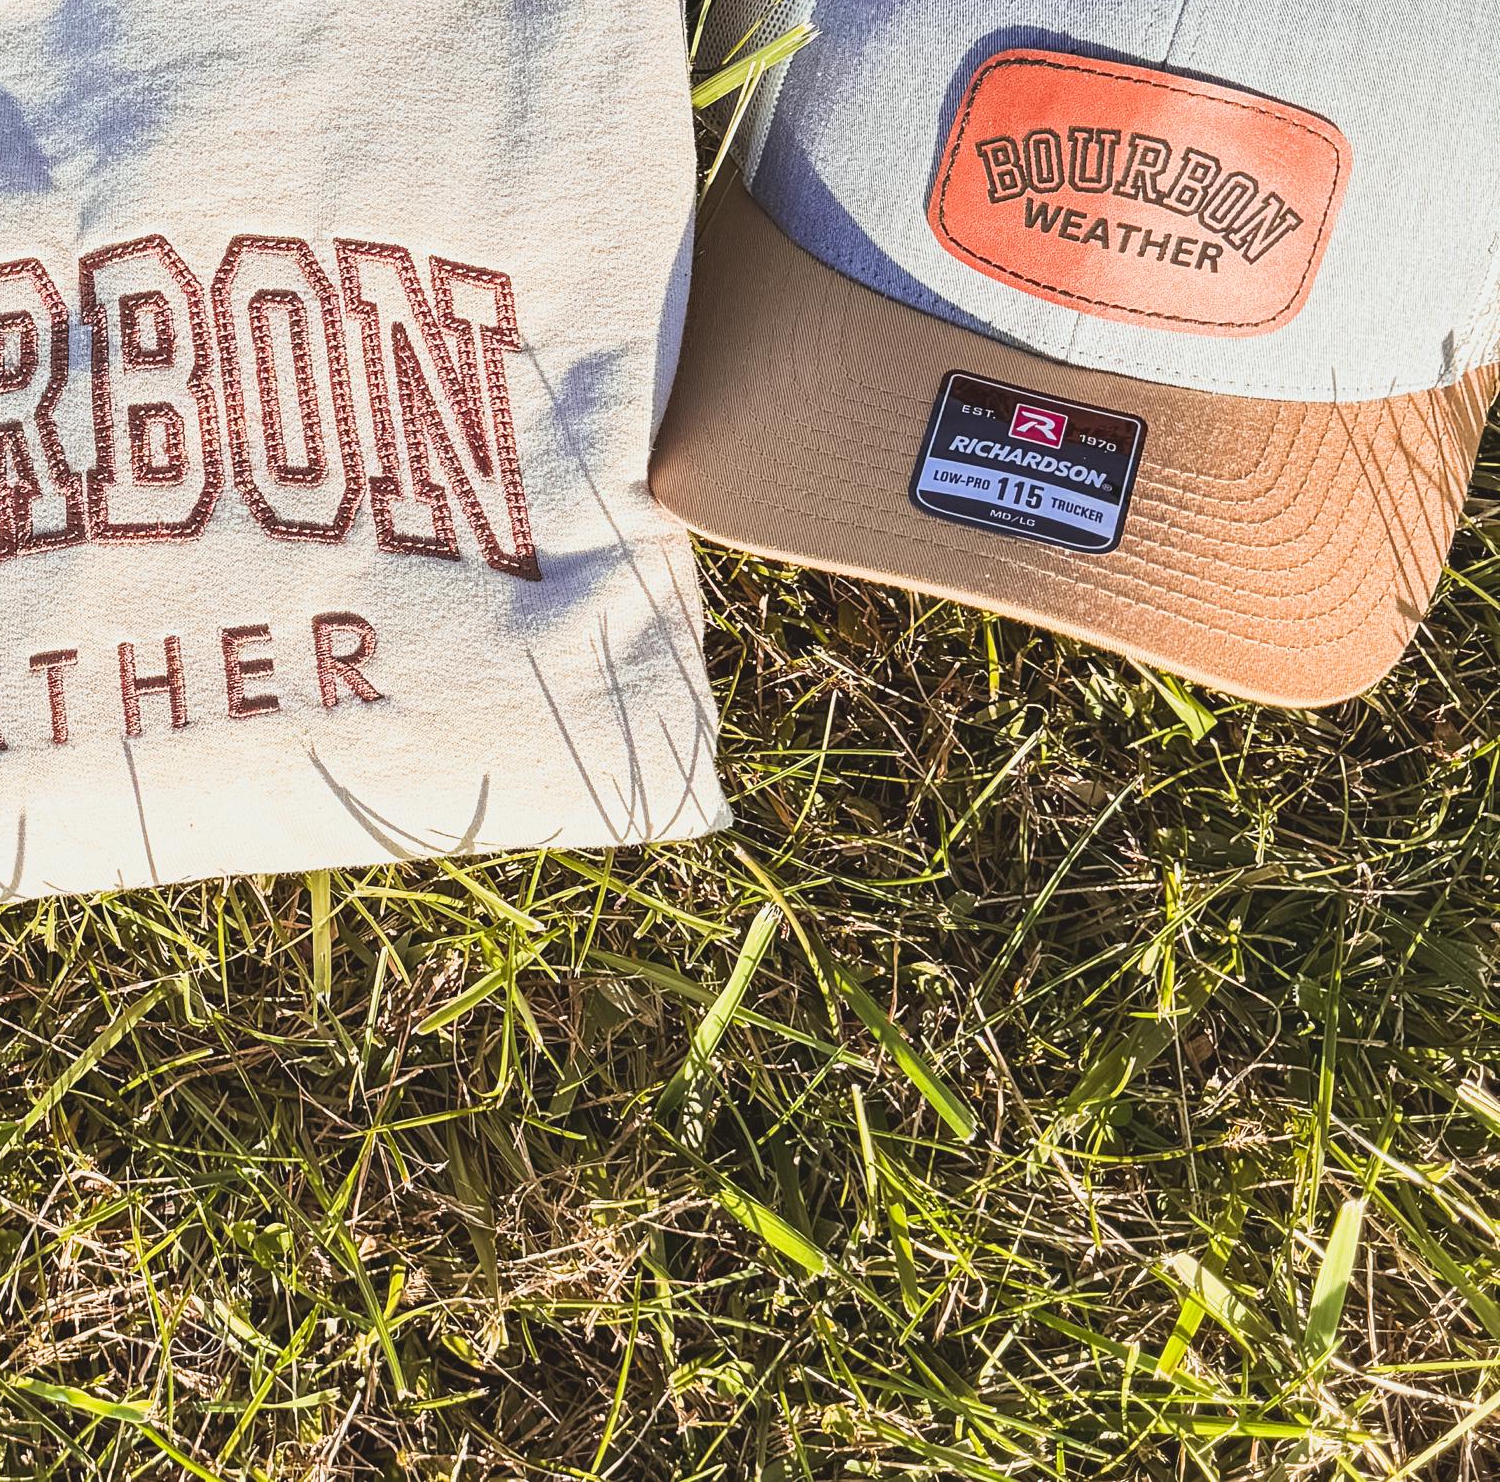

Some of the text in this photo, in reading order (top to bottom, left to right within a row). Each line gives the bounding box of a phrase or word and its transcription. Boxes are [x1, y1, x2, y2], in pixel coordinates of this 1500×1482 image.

[975, 126, 1301, 265] BOURBON
[1022, 196, 1224, 274] WEATHER
[961, 404, 1117, 452] EST. 1970
[933, 469, 1104, 524] LOW-PRO 115 TRUCKER
[989, 509, 1036, 527] MD/LG
